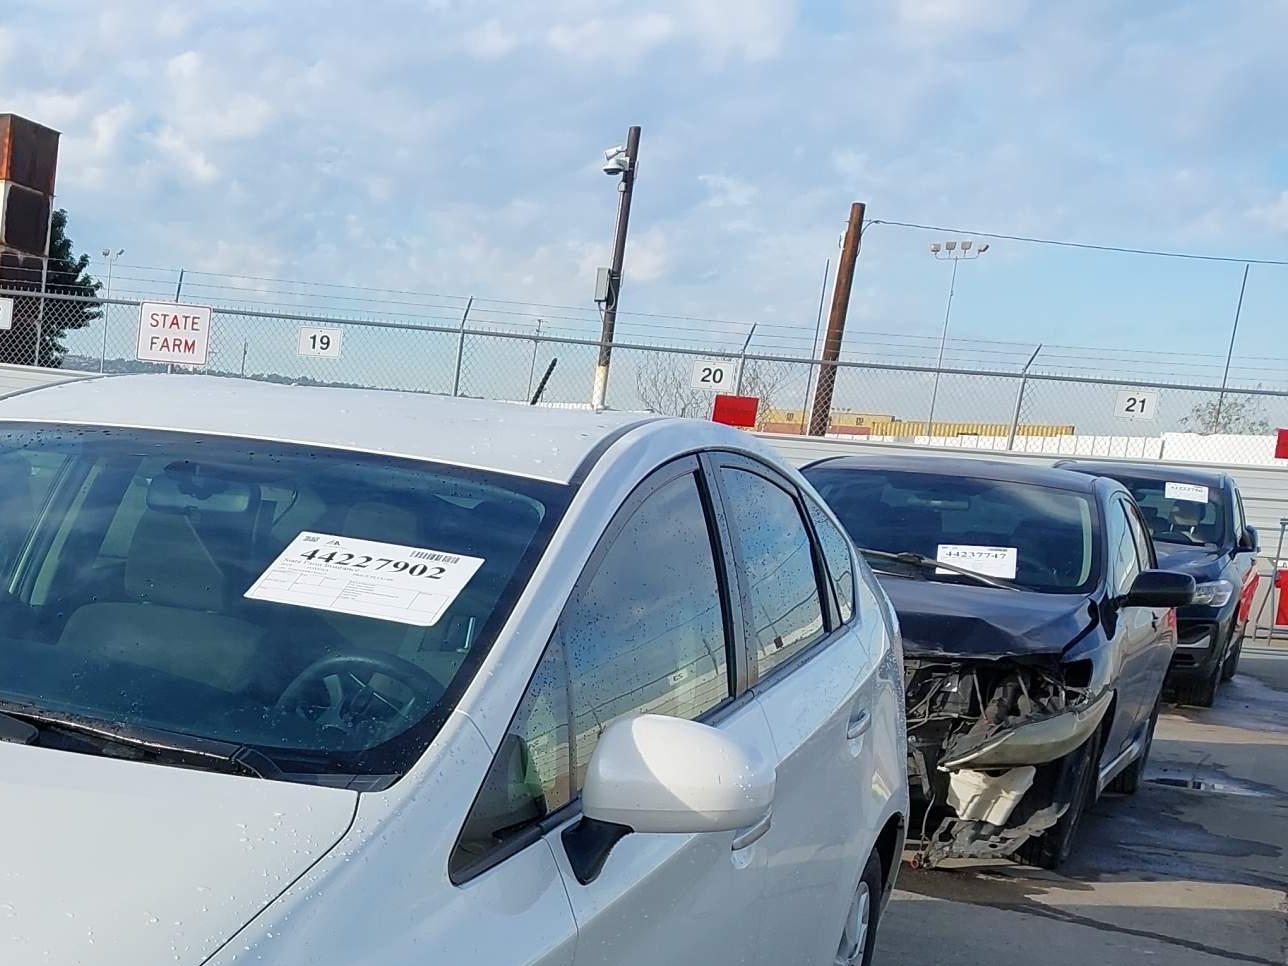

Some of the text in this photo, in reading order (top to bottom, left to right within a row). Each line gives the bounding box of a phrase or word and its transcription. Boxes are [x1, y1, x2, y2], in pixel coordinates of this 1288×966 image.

[149, 312, 201, 331] STATE
[149, 336, 196, 354] FARM
[309, 334, 331, 350] 19
[700, 367, 724, 384] 20
[1124, 397, 1147, 413] 21
[300, 548, 447, 580] 44227902
